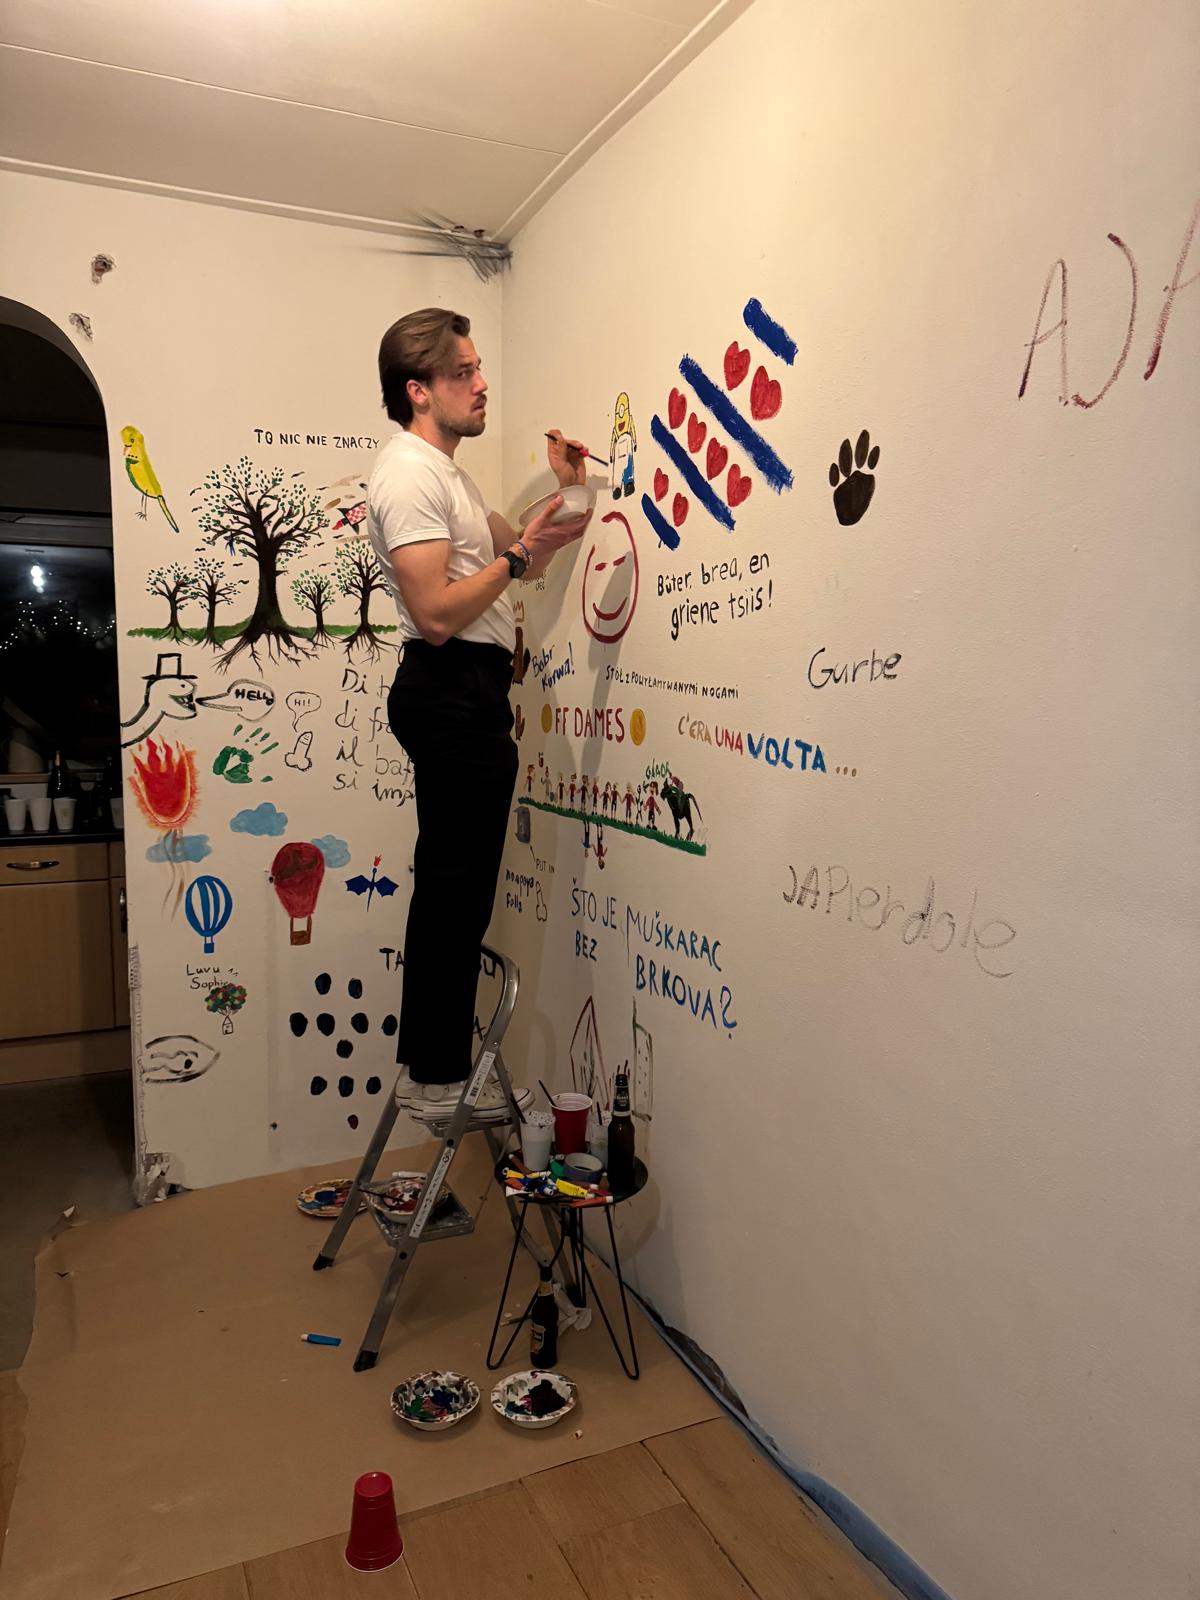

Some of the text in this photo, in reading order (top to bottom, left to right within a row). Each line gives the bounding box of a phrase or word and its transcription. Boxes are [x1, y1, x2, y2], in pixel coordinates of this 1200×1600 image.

[254, 429, 380, 449] TO NIC NIE ZNACZY
[749, 553, 770, 575] en
[671, 598, 720, 641] griene
[340, 668, 368, 695] Di
[808, 647, 902, 689] Gurbe
[235, 689, 275, 706] HELLO
[294, 698, 312, 708] HI!
[335, 699, 360, 732] di
[574, 706, 625, 743] DAMES
[336, 736, 364, 767] il
[714, 725, 744, 755] UNA
[332, 770, 358, 791] si
[571, 877, 722, 973] ŠTO JE MUŠKARAC
[575, 929, 738, 1040] BEZ BRKOVA?
